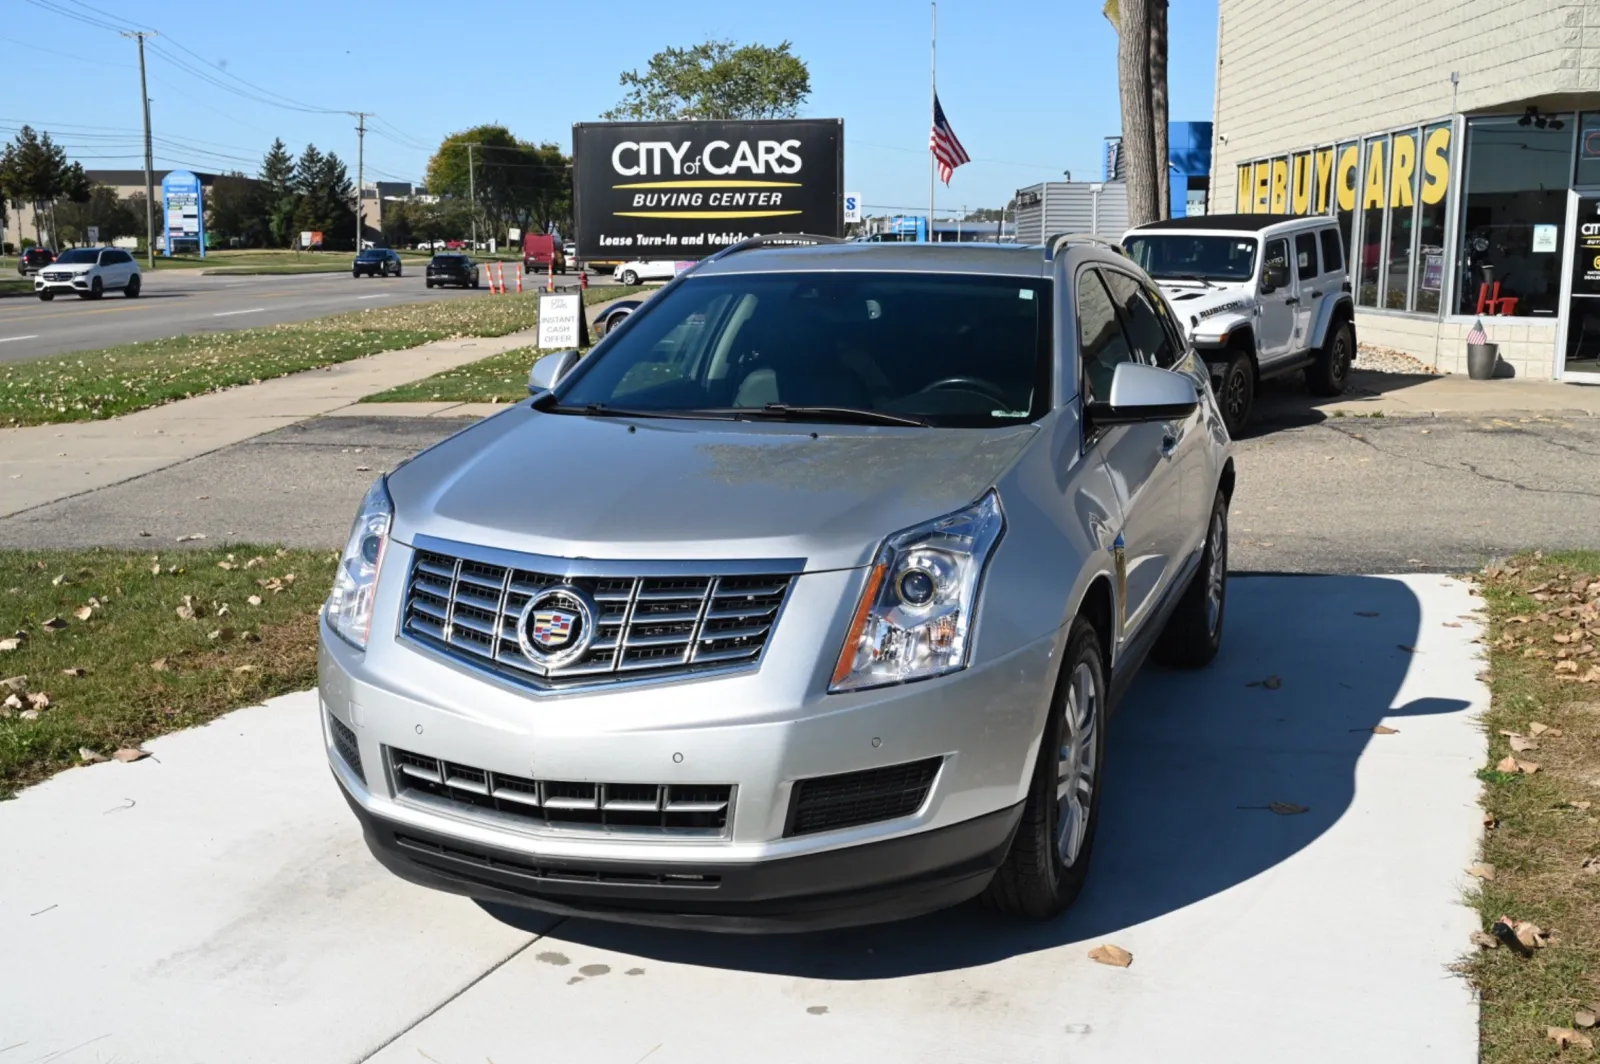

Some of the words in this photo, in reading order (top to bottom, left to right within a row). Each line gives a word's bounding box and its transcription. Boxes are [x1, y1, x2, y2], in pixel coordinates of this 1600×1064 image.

[611, 141, 692, 176] CITY
[683, 155, 703, 175] of
[702, 139, 802, 175] CARS
[1337, 128, 1451, 211] CARS
[632, 193, 702, 207] BUYING
[709, 192, 782, 207] CENTER
[845, 197, 856, 210] S
[600, 234, 633, 246] Lease
[636, 233, 678, 246] Turn-In
[681, 233, 704, 246] and
[1199, 300, 1239, 318] RUBICON
[541, 316, 574, 324] INSTANT
